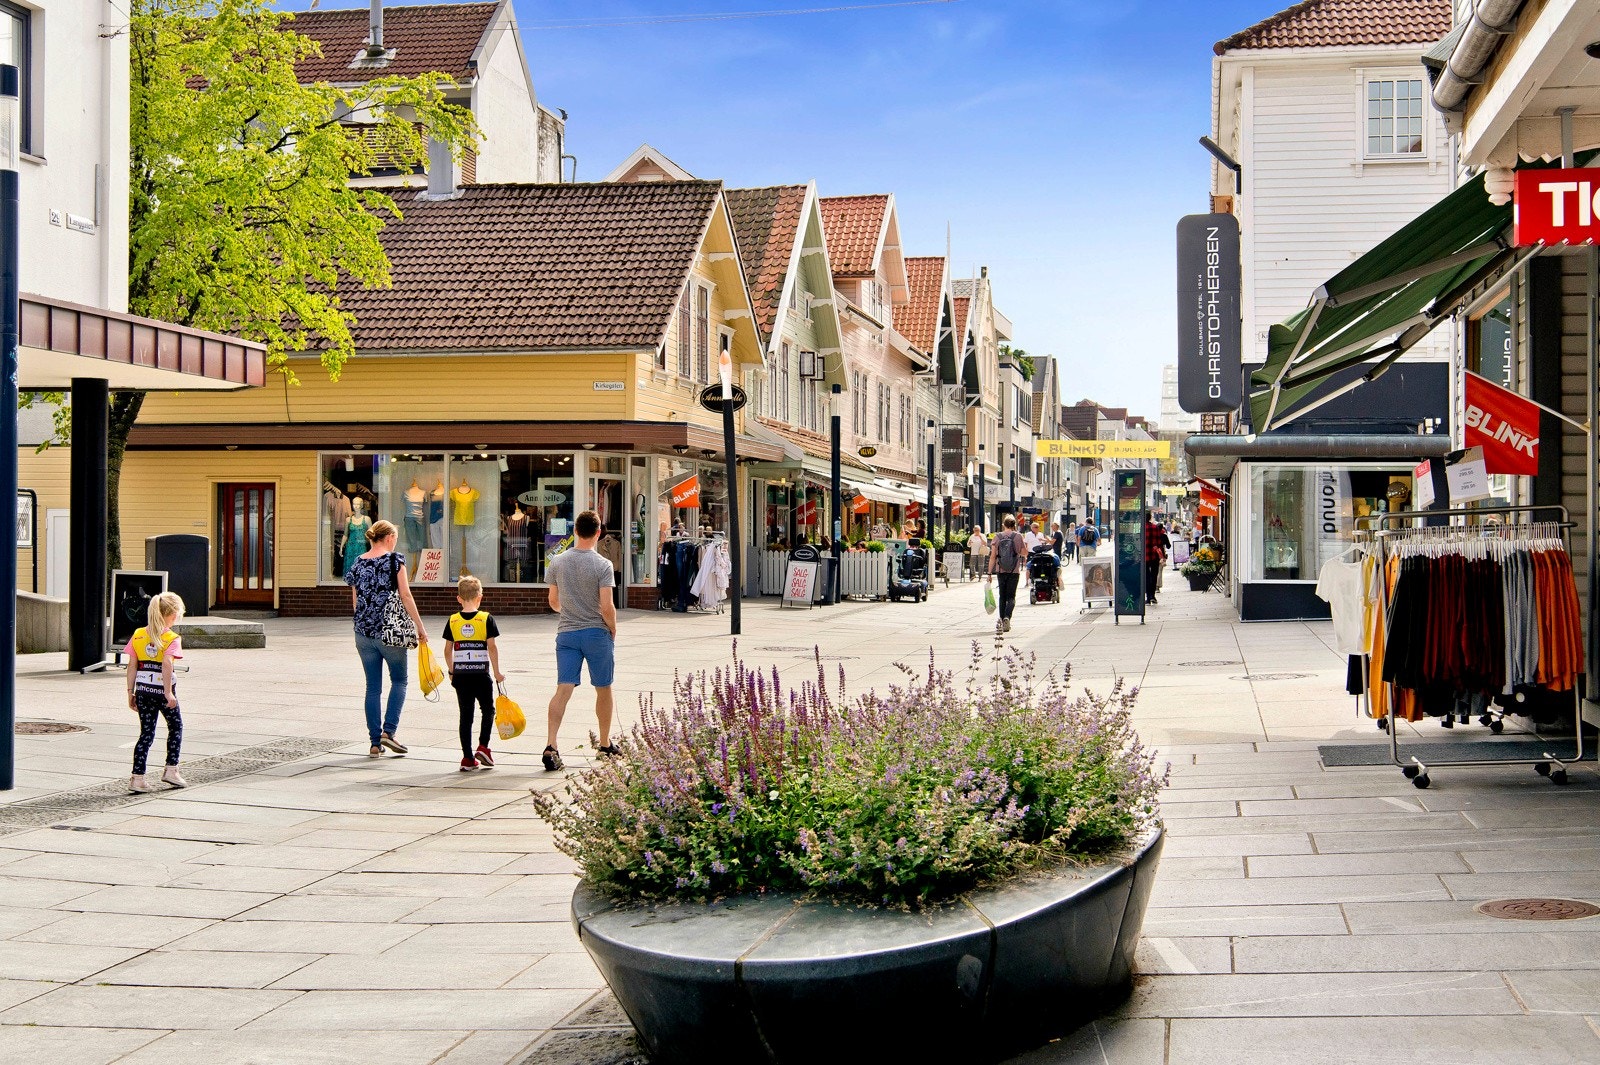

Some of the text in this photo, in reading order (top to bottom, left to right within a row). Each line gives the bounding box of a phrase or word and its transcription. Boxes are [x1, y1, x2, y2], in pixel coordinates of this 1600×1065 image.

[1539, 182, 1600, 227] TI
[1206, 226, 1221, 399] CHRISTOPHERSEN
[1464, 404, 1540, 459] BLINK
[1049, 443, 1106, 455] BLINK19
[673, 486, 698, 504] BLINK
[427, 551, 442, 560] SALG
[424, 562, 440, 571] SALG
[422, 571, 438, 581] SALG
[793, 567, 809, 578] SALG
[791, 577, 807, 589] SALG
[790, 587, 806, 598] SALG
[466, 651, 471, 660] 1
[149, 673, 154, 682] 1
